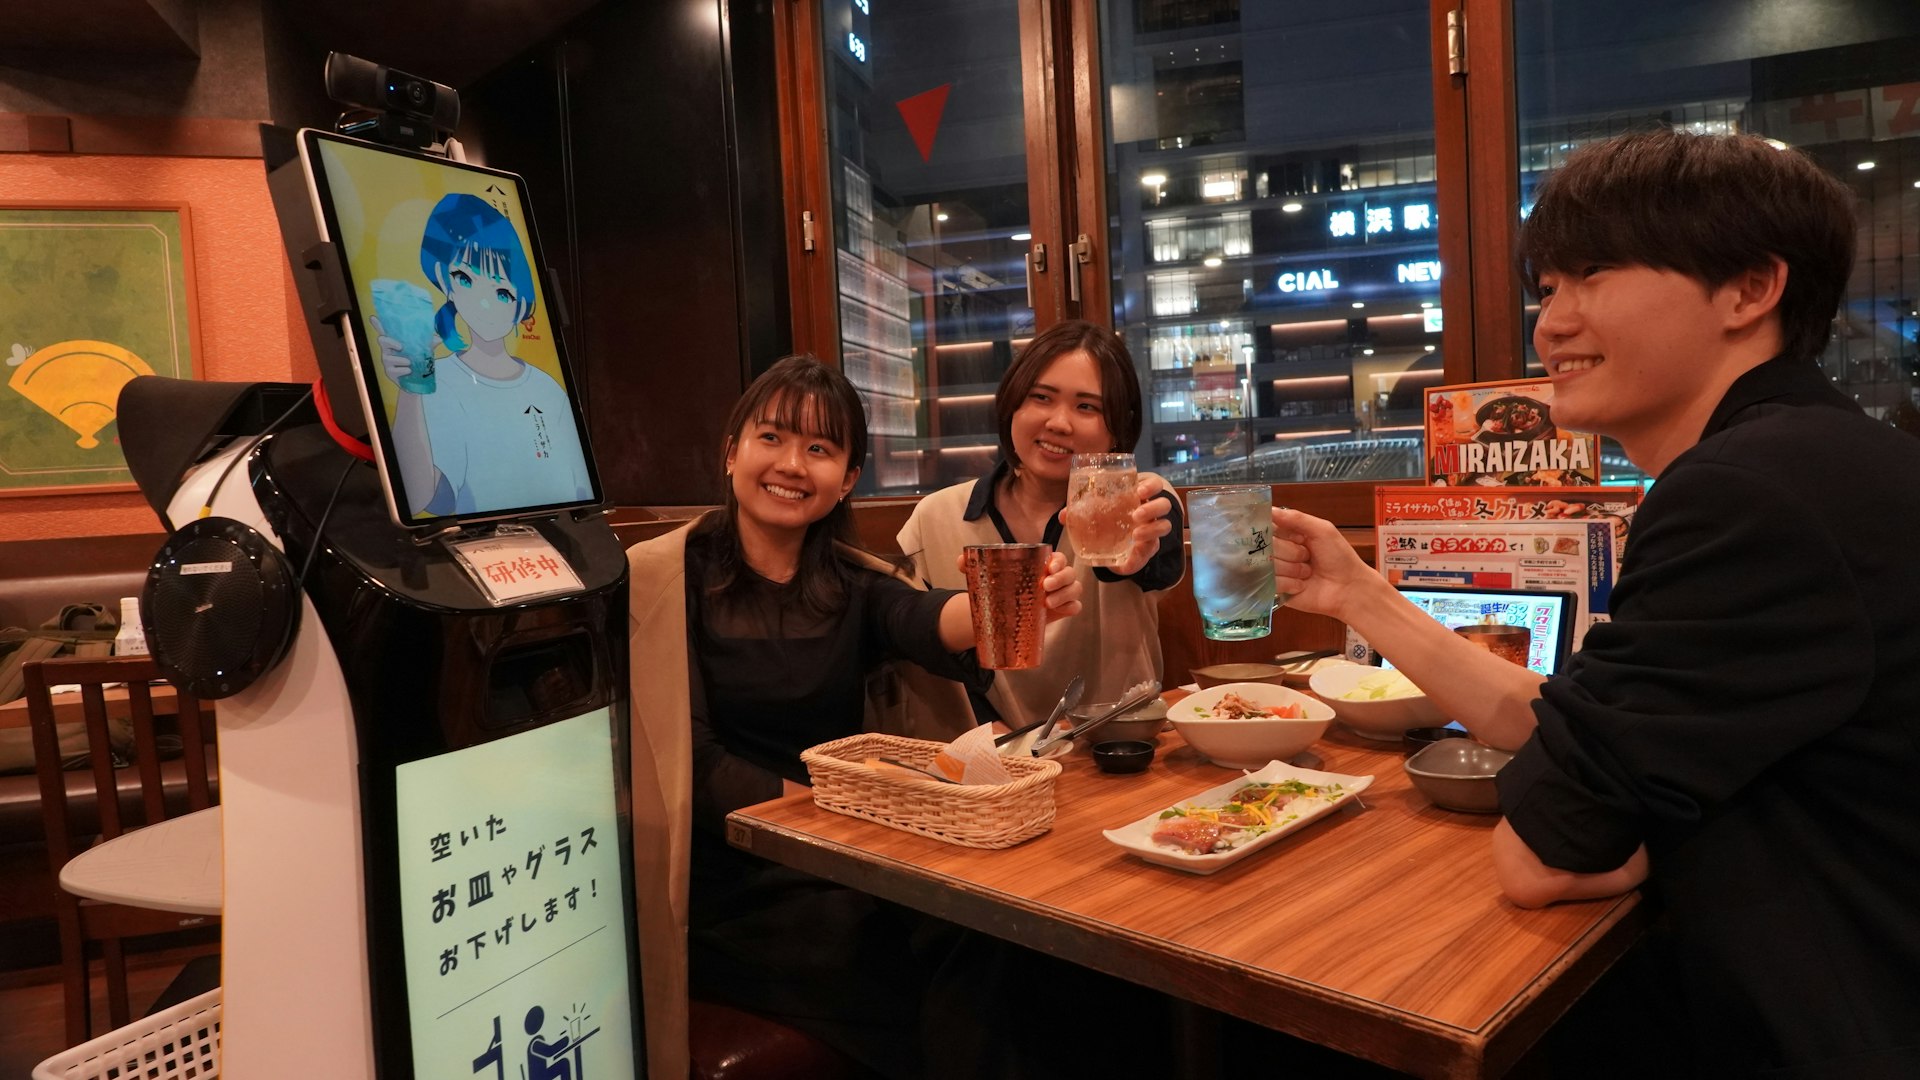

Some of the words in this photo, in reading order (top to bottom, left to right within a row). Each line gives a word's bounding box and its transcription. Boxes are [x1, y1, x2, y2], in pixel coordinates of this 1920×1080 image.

[1329, 204, 1438, 237] 横浜駅
[1278, 269, 1339, 292] CIAL
[1434, 437, 1591, 475] MIRAIZAKA
[1474, 498, 1548, 521] 冬グルメ
[483, 554, 560, 584] 研修中
[430, 814, 507, 863] 空いた
[432, 827, 598, 924] お皿やグラス
[439, 878, 598, 977] お下げします!
